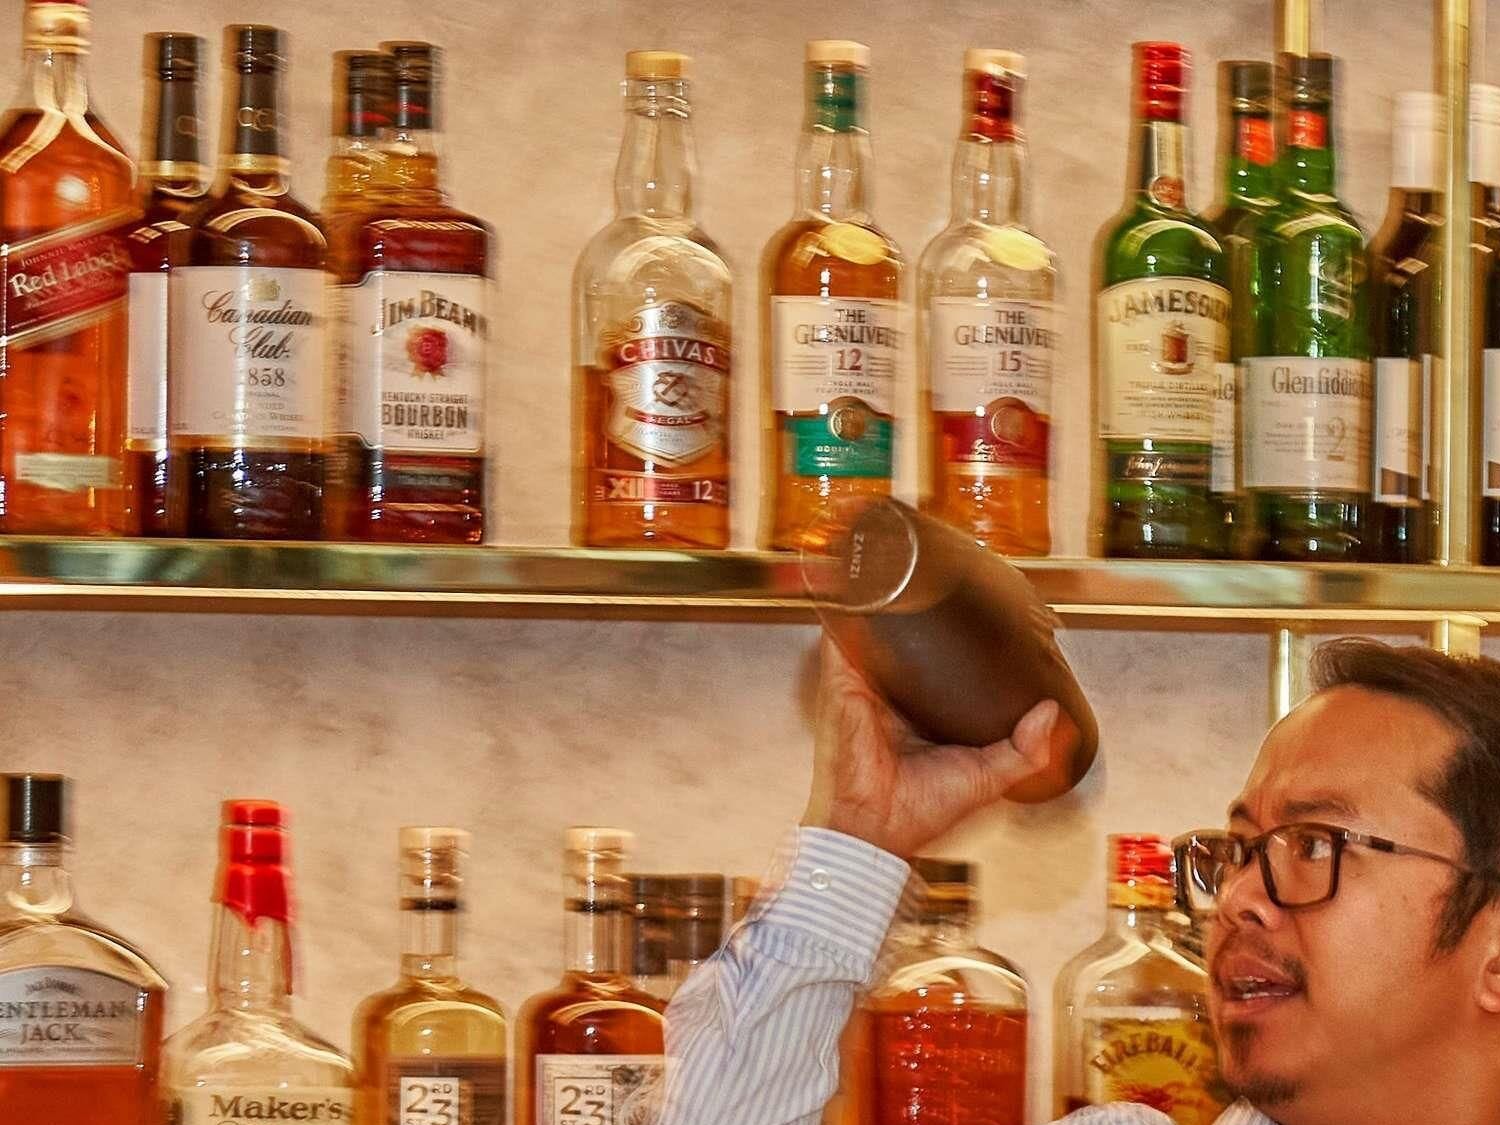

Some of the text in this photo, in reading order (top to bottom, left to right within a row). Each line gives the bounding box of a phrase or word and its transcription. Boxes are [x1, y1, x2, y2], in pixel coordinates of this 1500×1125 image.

[9, 265, 57, 298] Red
[833, 308, 866, 323] THE
[994, 310, 1026, 326] THE
[619, 339, 717, 366] CHIVAS
[835, 348, 864, 371] 12
[998, 350, 1024, 373] 15
[242, 368, 286, 388] 858
[381, 403, 469, 429] BOURBON
[693, 479, 714, 501] 12
[20, 1022, 81, 1044] JACK
[209, 1093, 345, 1121] Maker's
